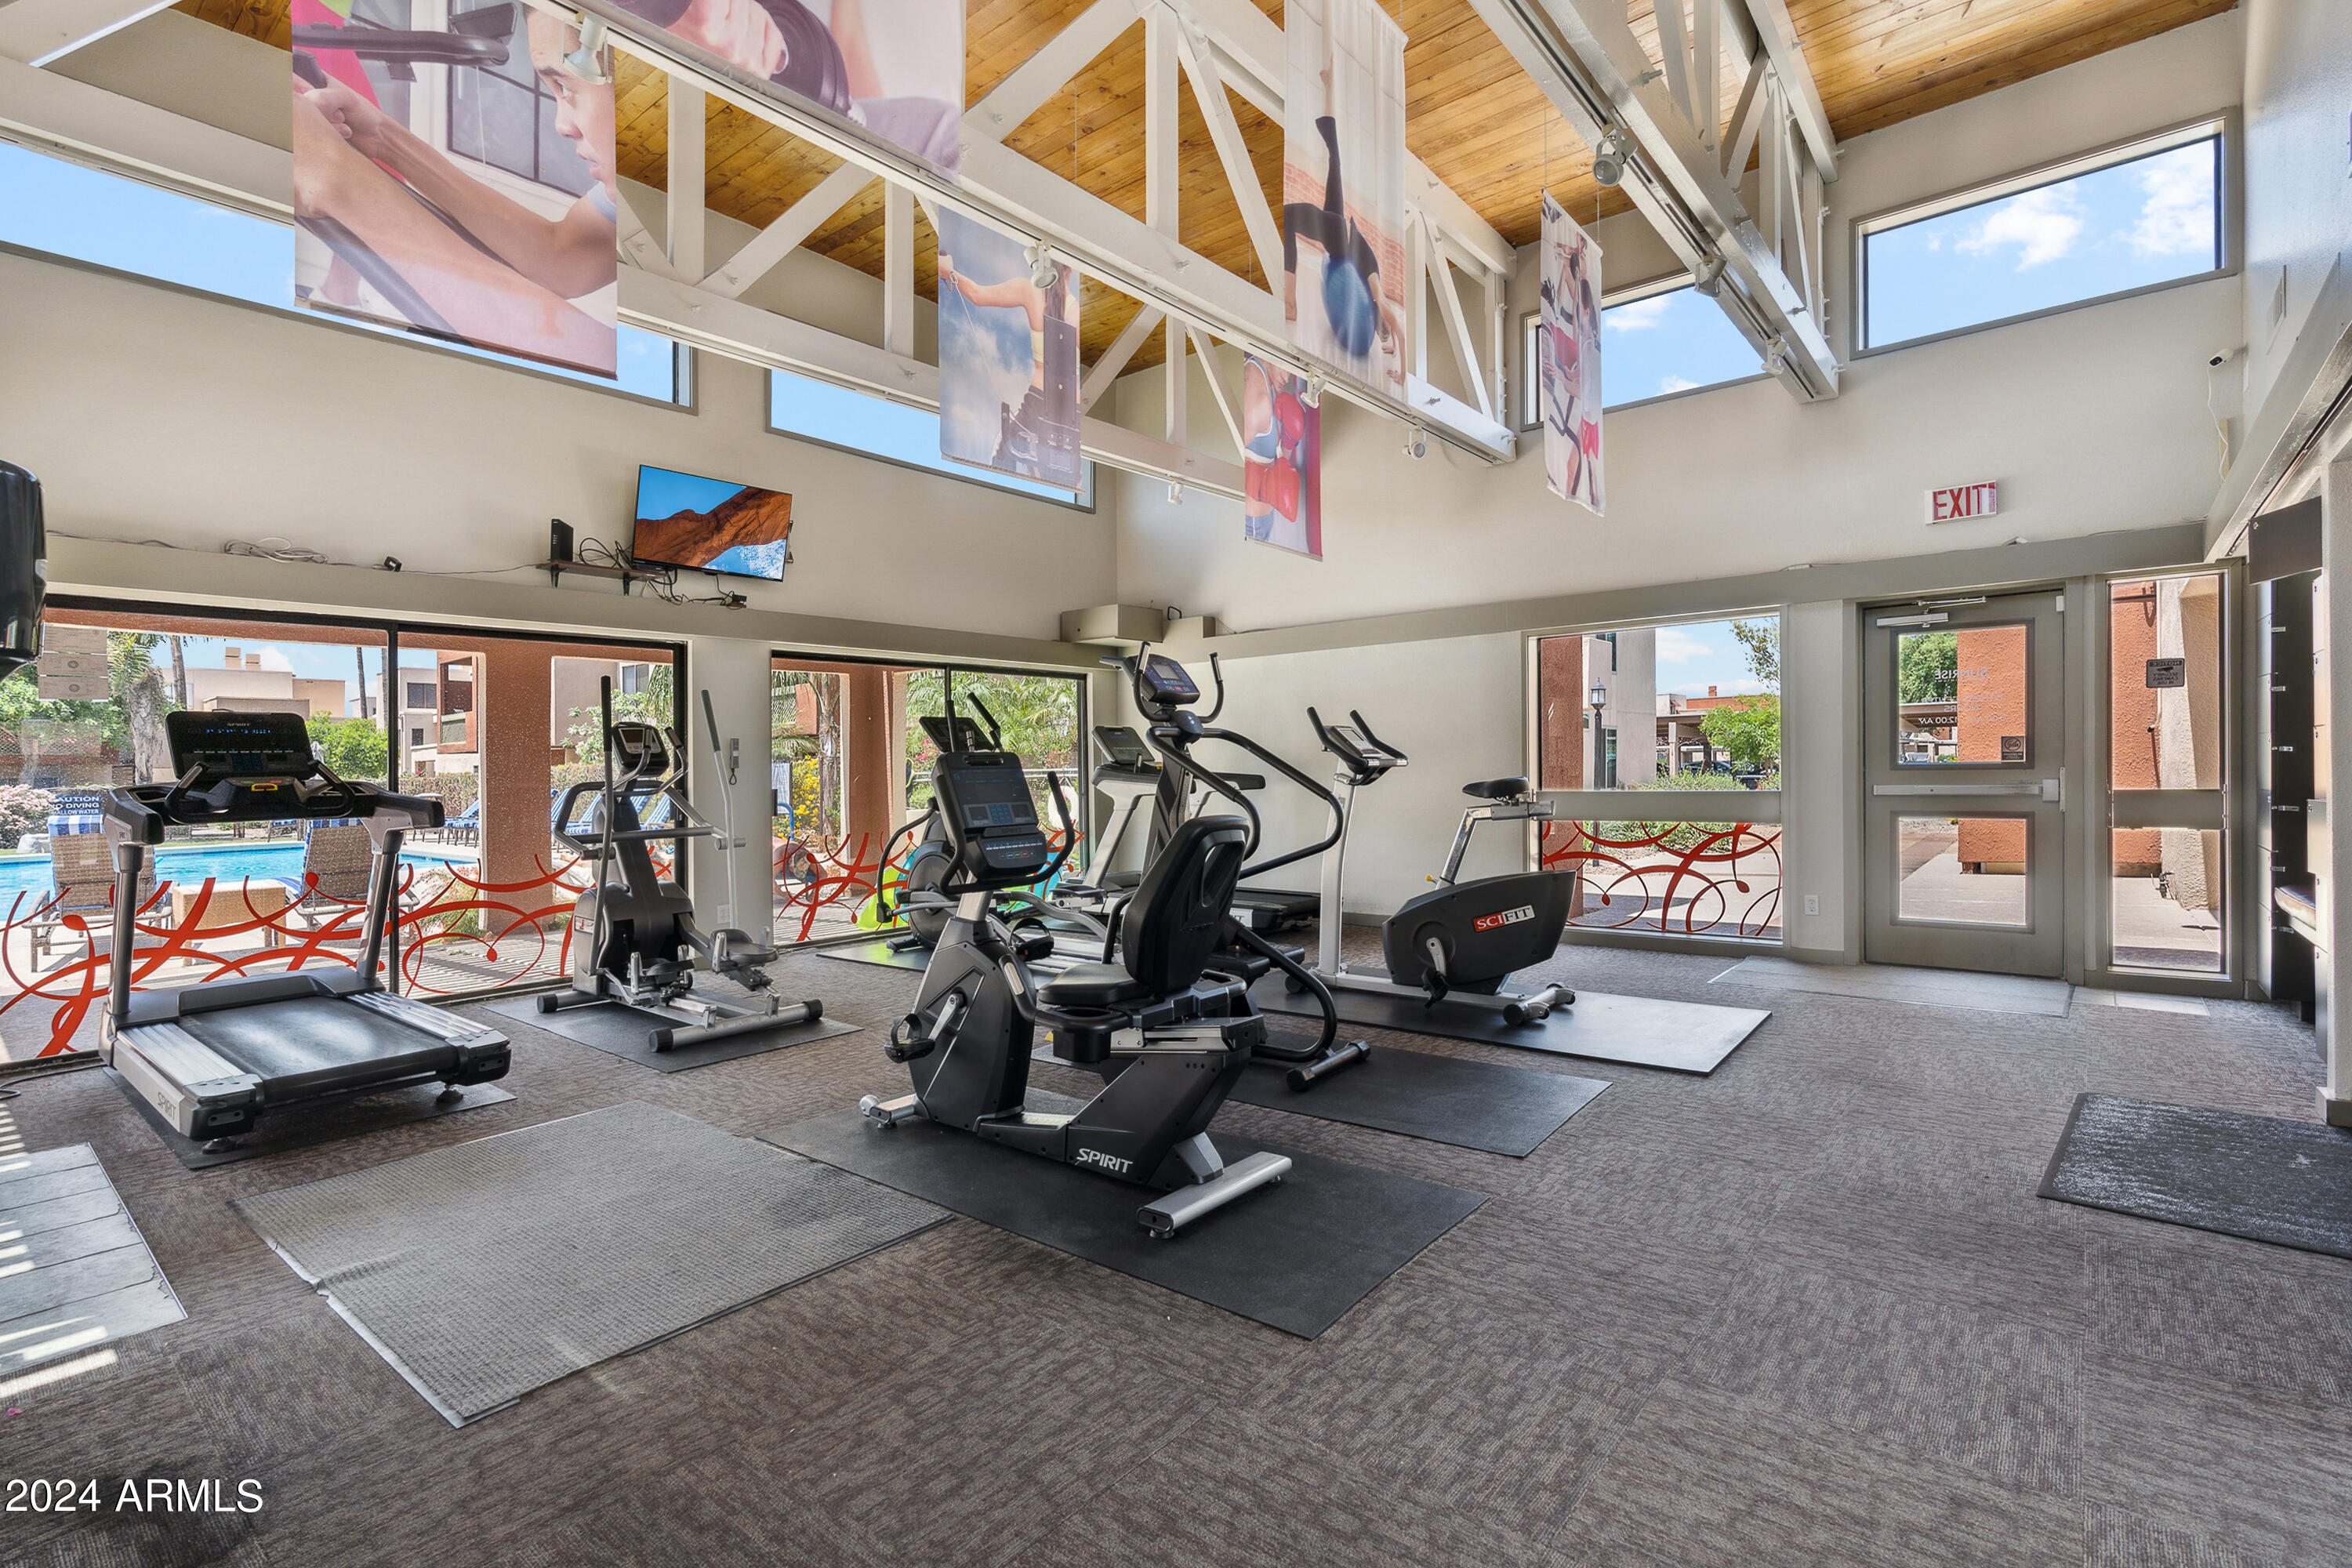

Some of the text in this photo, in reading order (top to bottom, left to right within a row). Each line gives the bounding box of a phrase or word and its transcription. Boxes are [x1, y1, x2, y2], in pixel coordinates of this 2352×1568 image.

[1933, 483, 1987, 521] EXIT
[1477, 907, 1530, 929] SCIFIT
[158, 1091, 176, 1121] SPIRIT
[1076, 1148, 1134, 1174] SPIRIT
